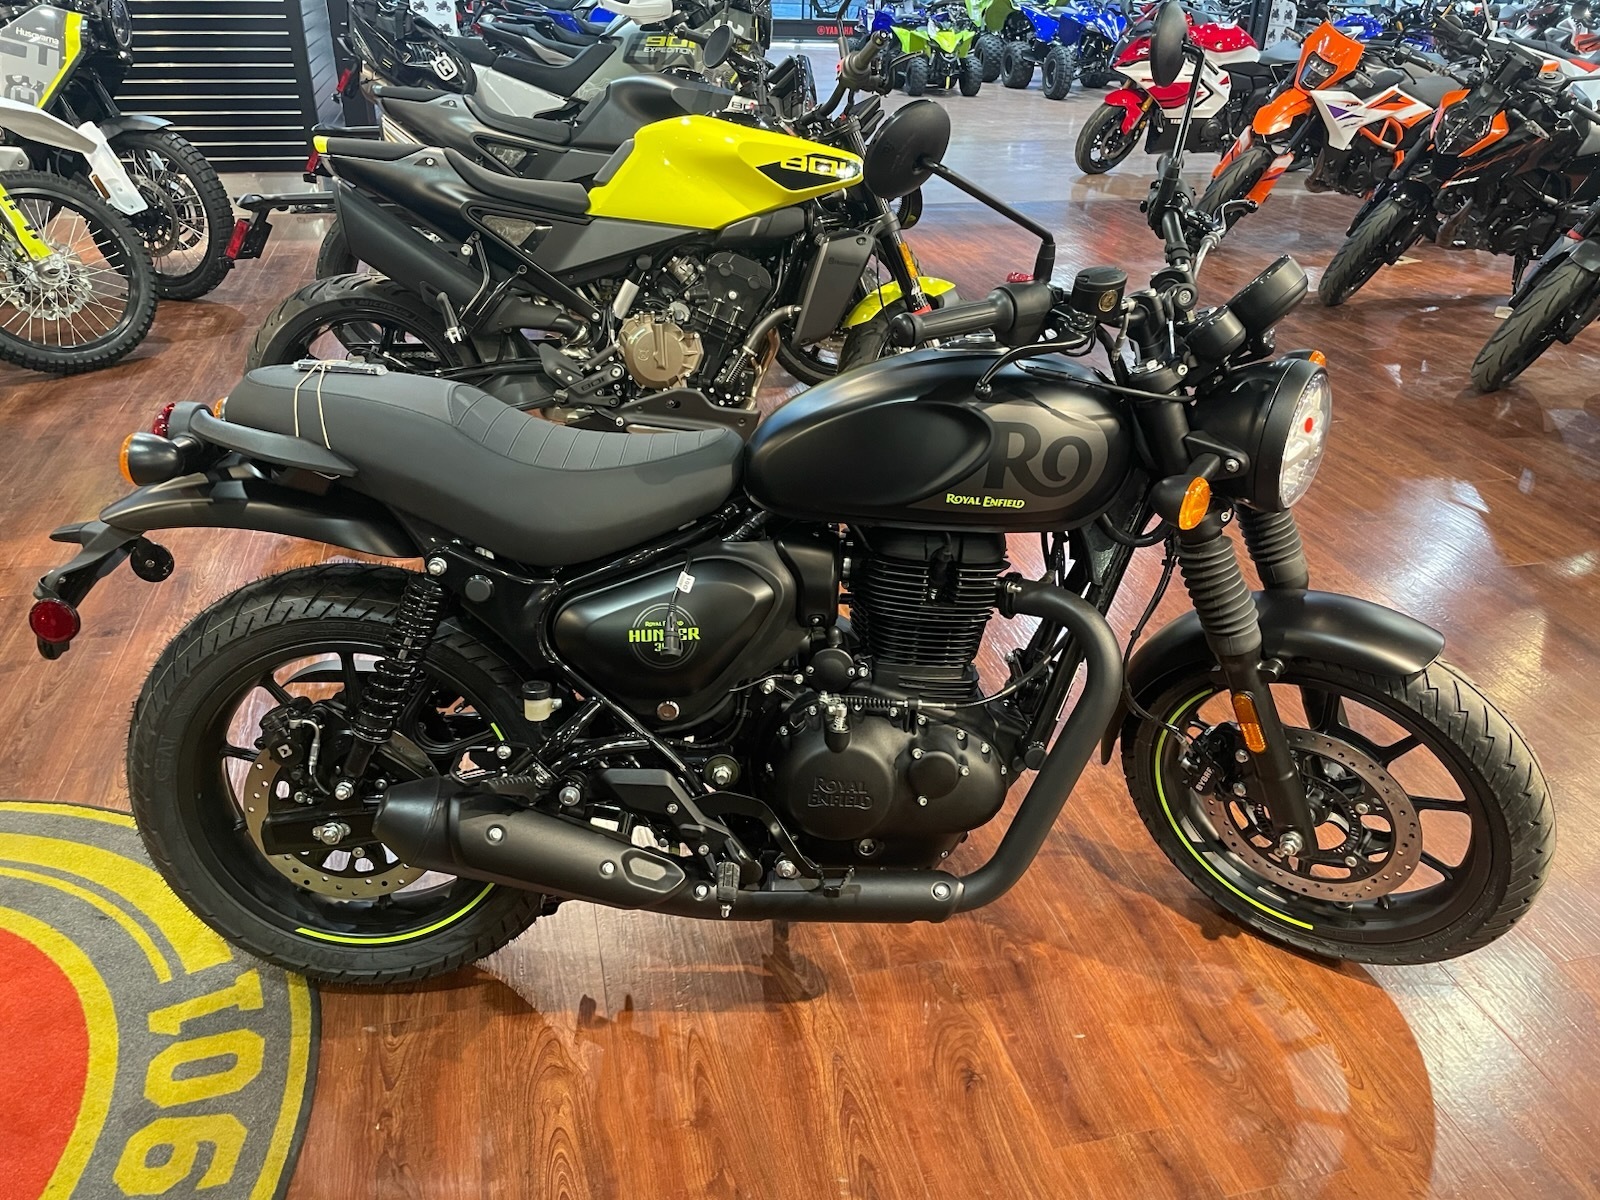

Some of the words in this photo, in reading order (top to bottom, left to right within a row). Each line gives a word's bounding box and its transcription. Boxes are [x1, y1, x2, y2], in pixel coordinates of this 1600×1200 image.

[15, 26, 60, 48] Husqvarna
[826, 26, 854, 35] YAMHA
[643, 46, 695, 56] EXPEDITION
[628, 627, 701, 643] HUNER
